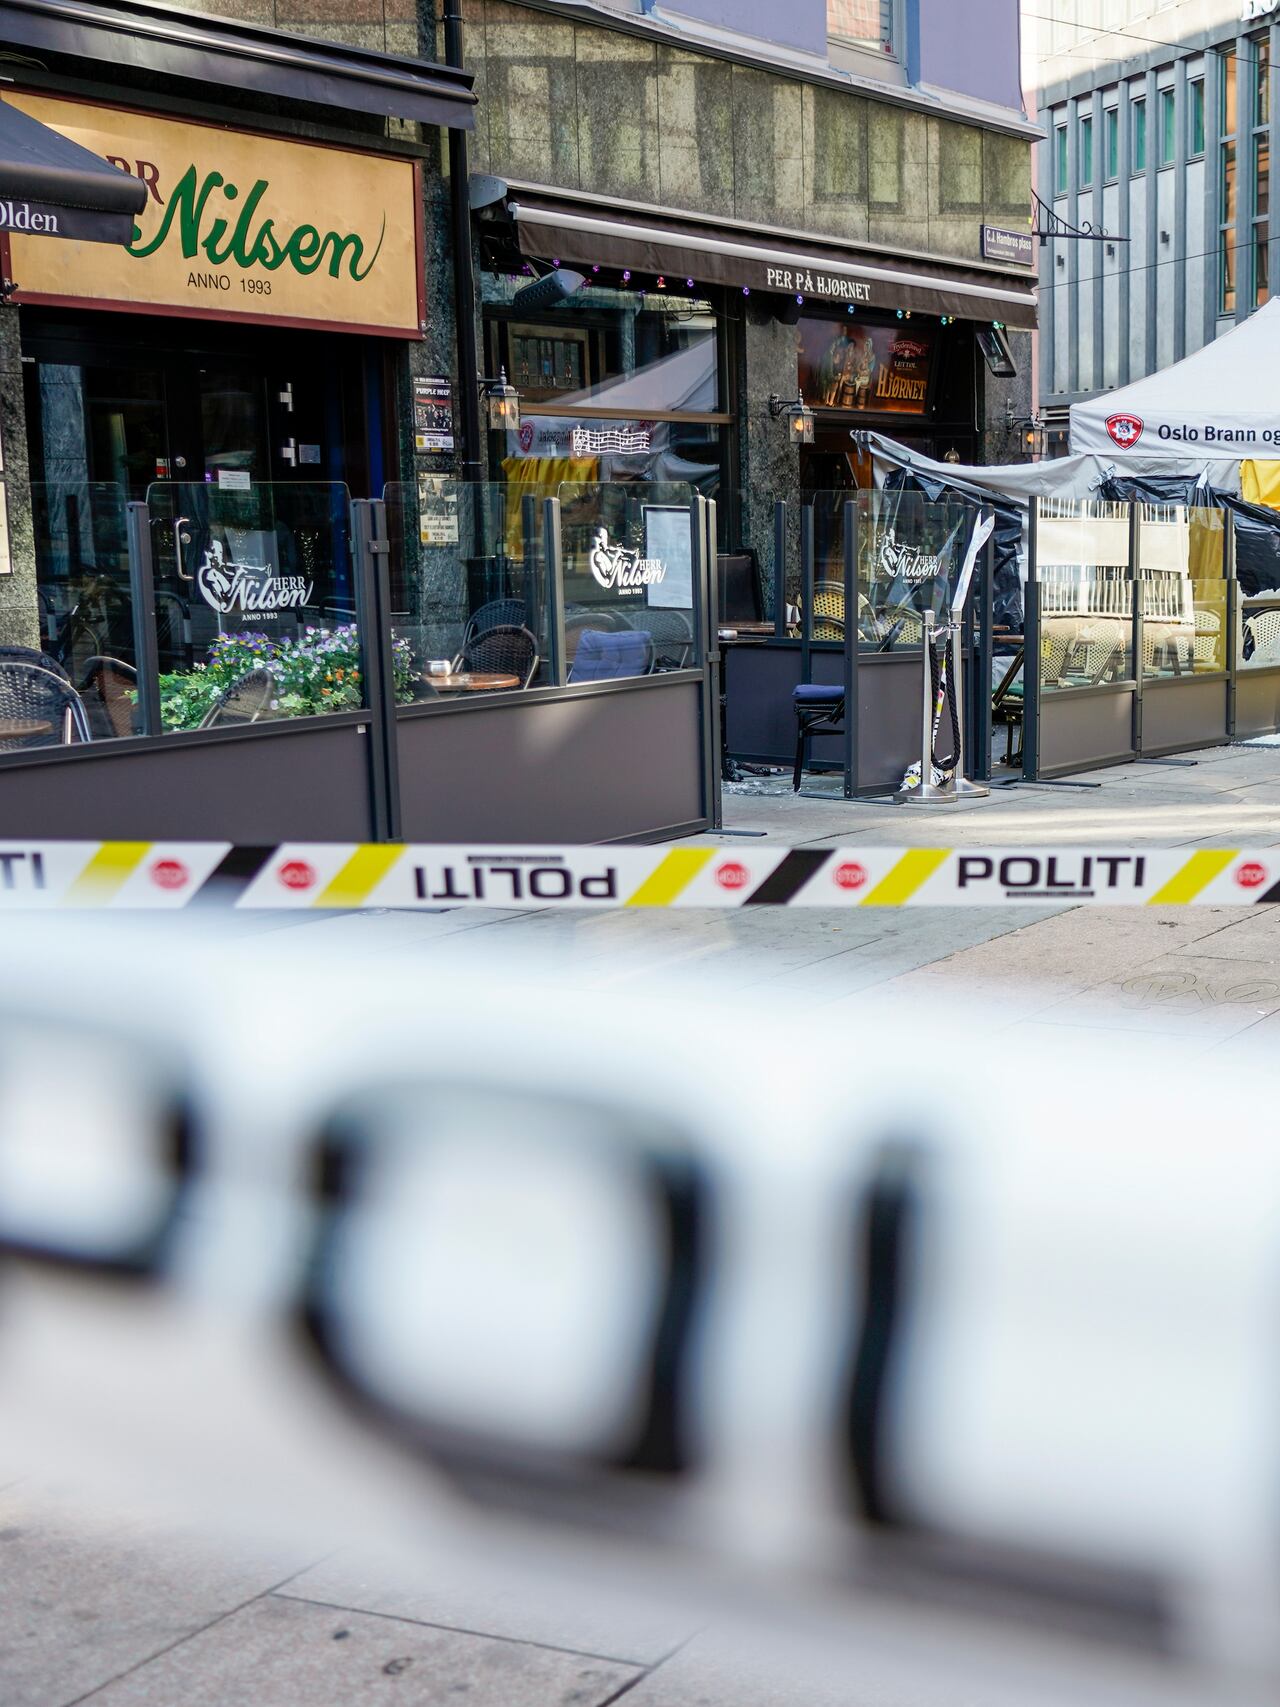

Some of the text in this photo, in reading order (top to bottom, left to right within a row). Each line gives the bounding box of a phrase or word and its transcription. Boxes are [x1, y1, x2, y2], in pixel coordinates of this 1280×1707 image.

[124, 163, 386, 282] Nilsen
[1019, 237, 1031, 251] plass
[187, 272, 272, 295] ANNO 1993
[767, 268, 870, 300] PER PÅ HJØRNET
[1158, 424, 1198, 441] Oslo
[1205, 426, 1256, 442] Brann
[272, 576, 306, 590] HERR
[605, 560, 667, 588] Nilsen
[221, 577, 313, 613] Nilsen
[242, 612, 278, 621] ANNO 1993
[414, 867, 617, 898] POLITI
[958, 856, 1145, 887] POLITI
